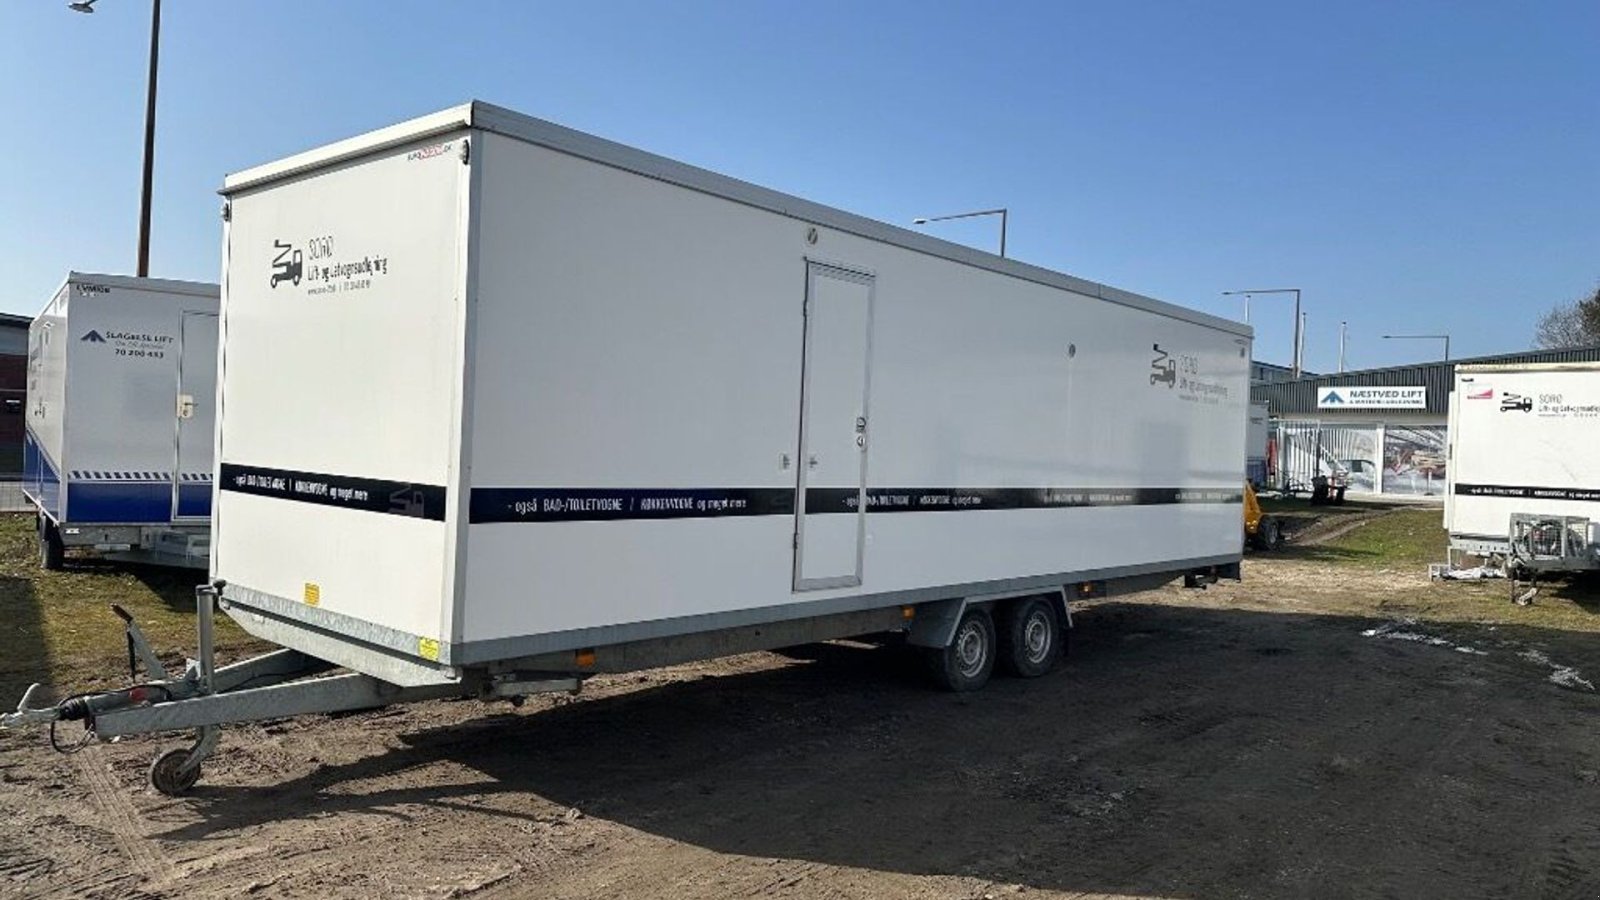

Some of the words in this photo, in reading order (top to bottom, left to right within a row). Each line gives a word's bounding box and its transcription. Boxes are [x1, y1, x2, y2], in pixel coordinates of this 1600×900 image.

[1350, 390, 1400, 398] NÆSTVED
[1401, 390, 1424, 398] LIFT
[515, 498, 538, 516] også
